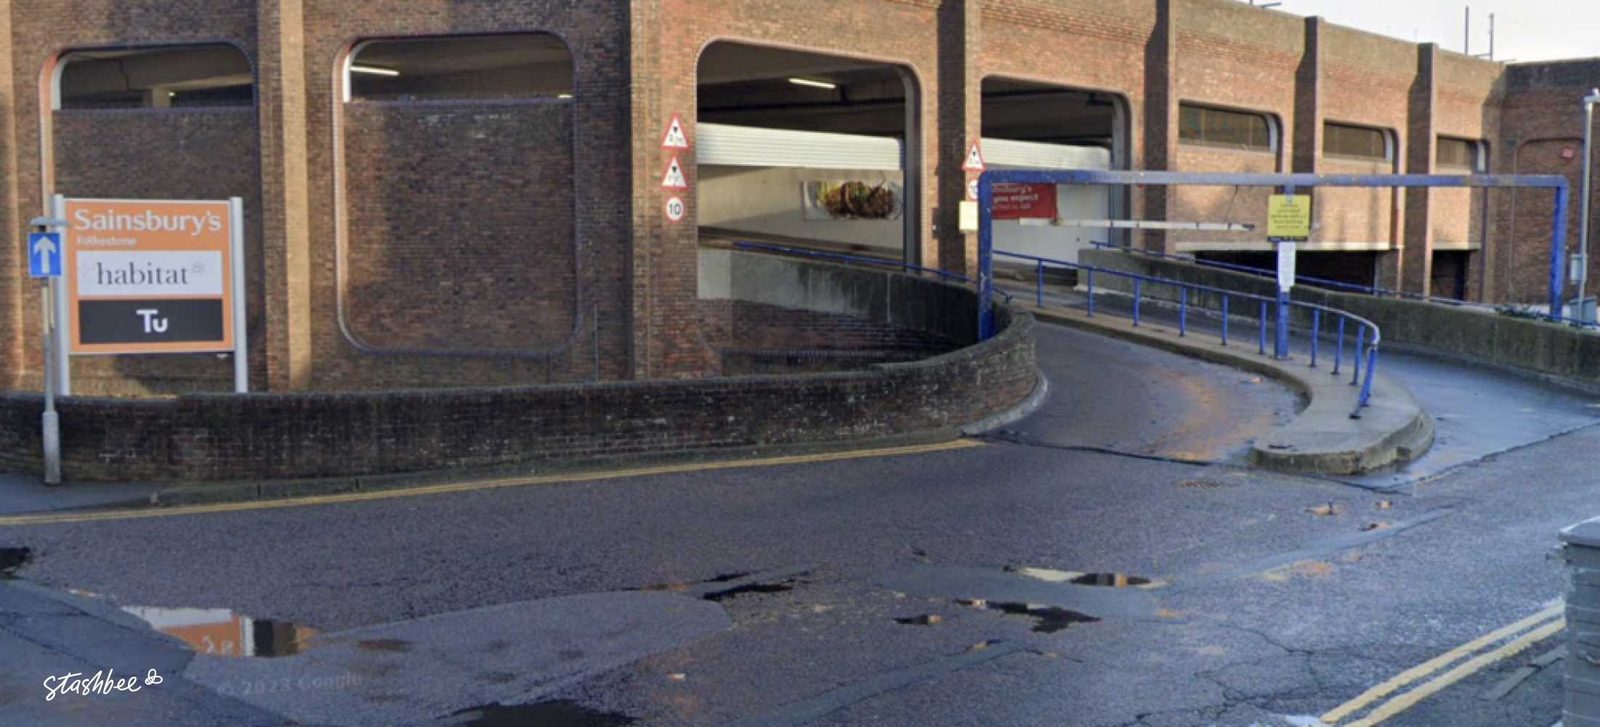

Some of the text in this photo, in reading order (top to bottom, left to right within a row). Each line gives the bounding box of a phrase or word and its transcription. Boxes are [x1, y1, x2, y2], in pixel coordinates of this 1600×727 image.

[1010, 193, 1039, 203] expect
[669, 203, 681, 216] 10
[74, 208, 222, 237] Sainsbury's
[76, 236, 138, 246] Folkestone
[97, 262, 190, 286] habitat
[136, 308, 169, 334] Tu
